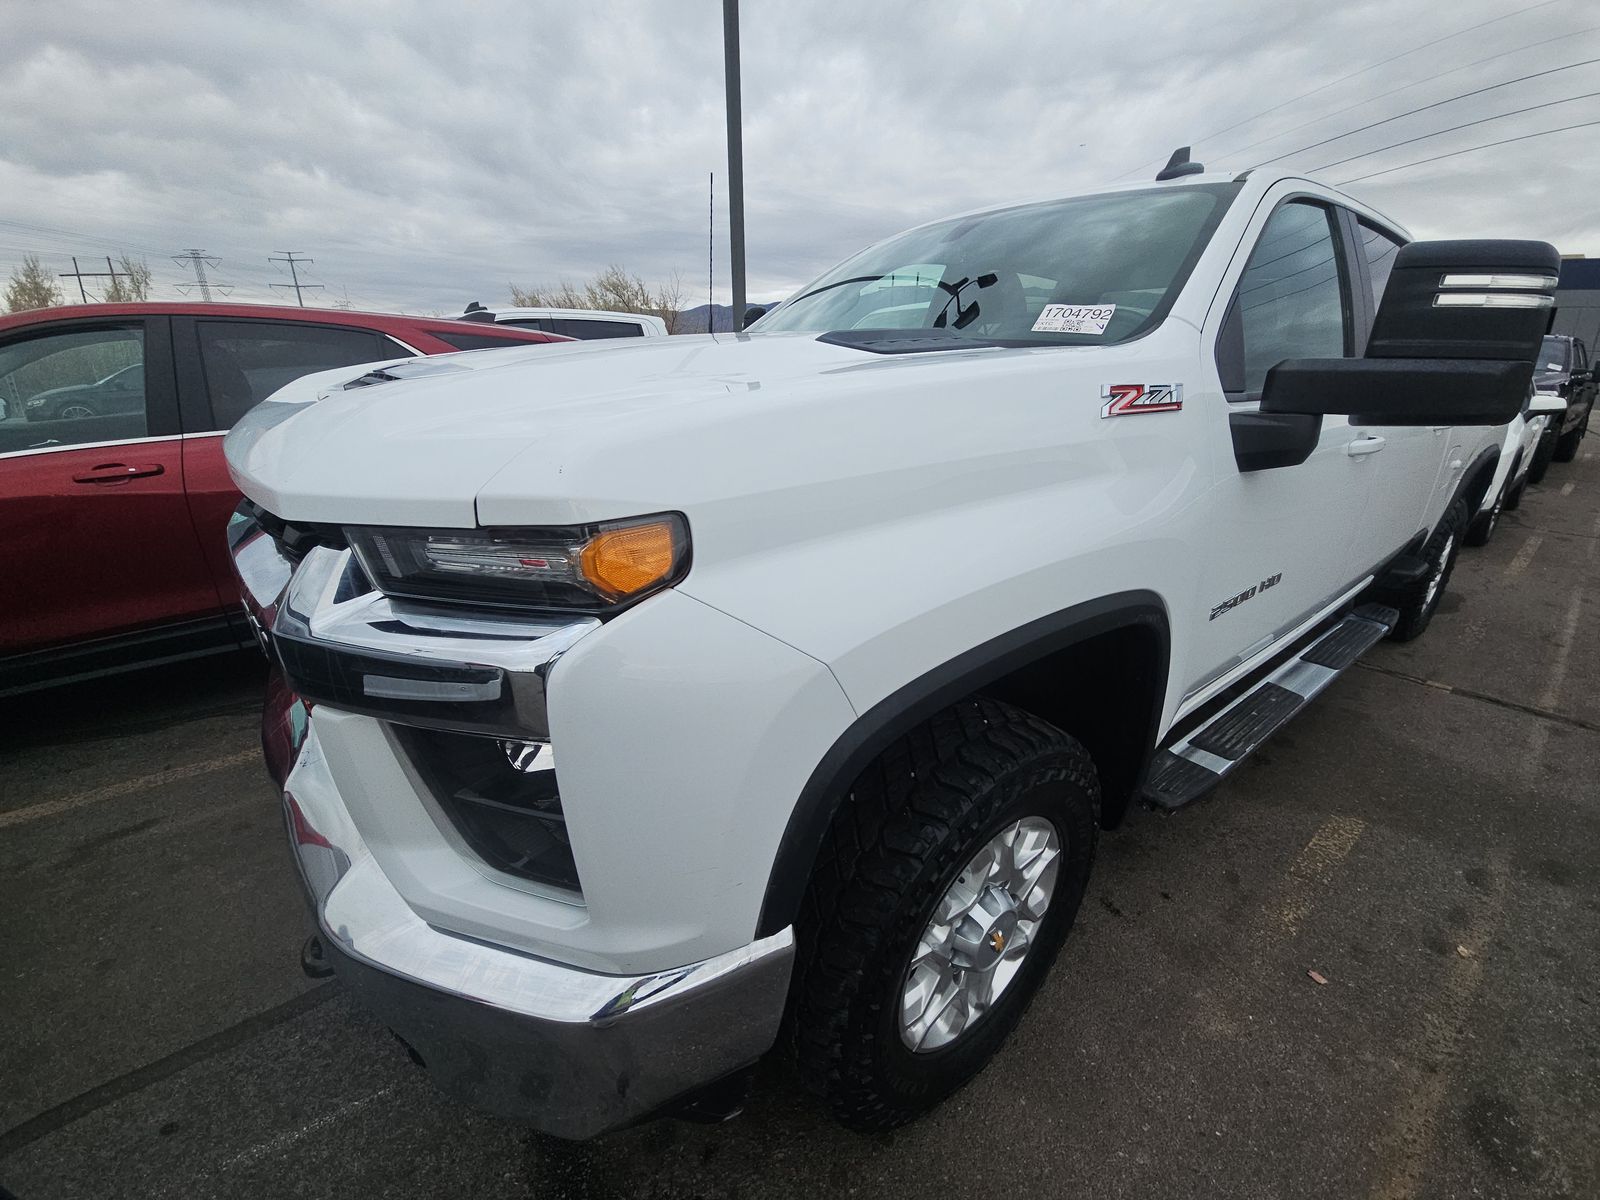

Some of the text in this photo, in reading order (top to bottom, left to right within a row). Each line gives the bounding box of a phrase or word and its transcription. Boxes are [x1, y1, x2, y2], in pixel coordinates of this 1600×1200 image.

[1045, 307, 1112, 320] 1704792
[1101, 384, 1183, 419] Z71
[1209, 572, 1282, 621] 2500 HD
